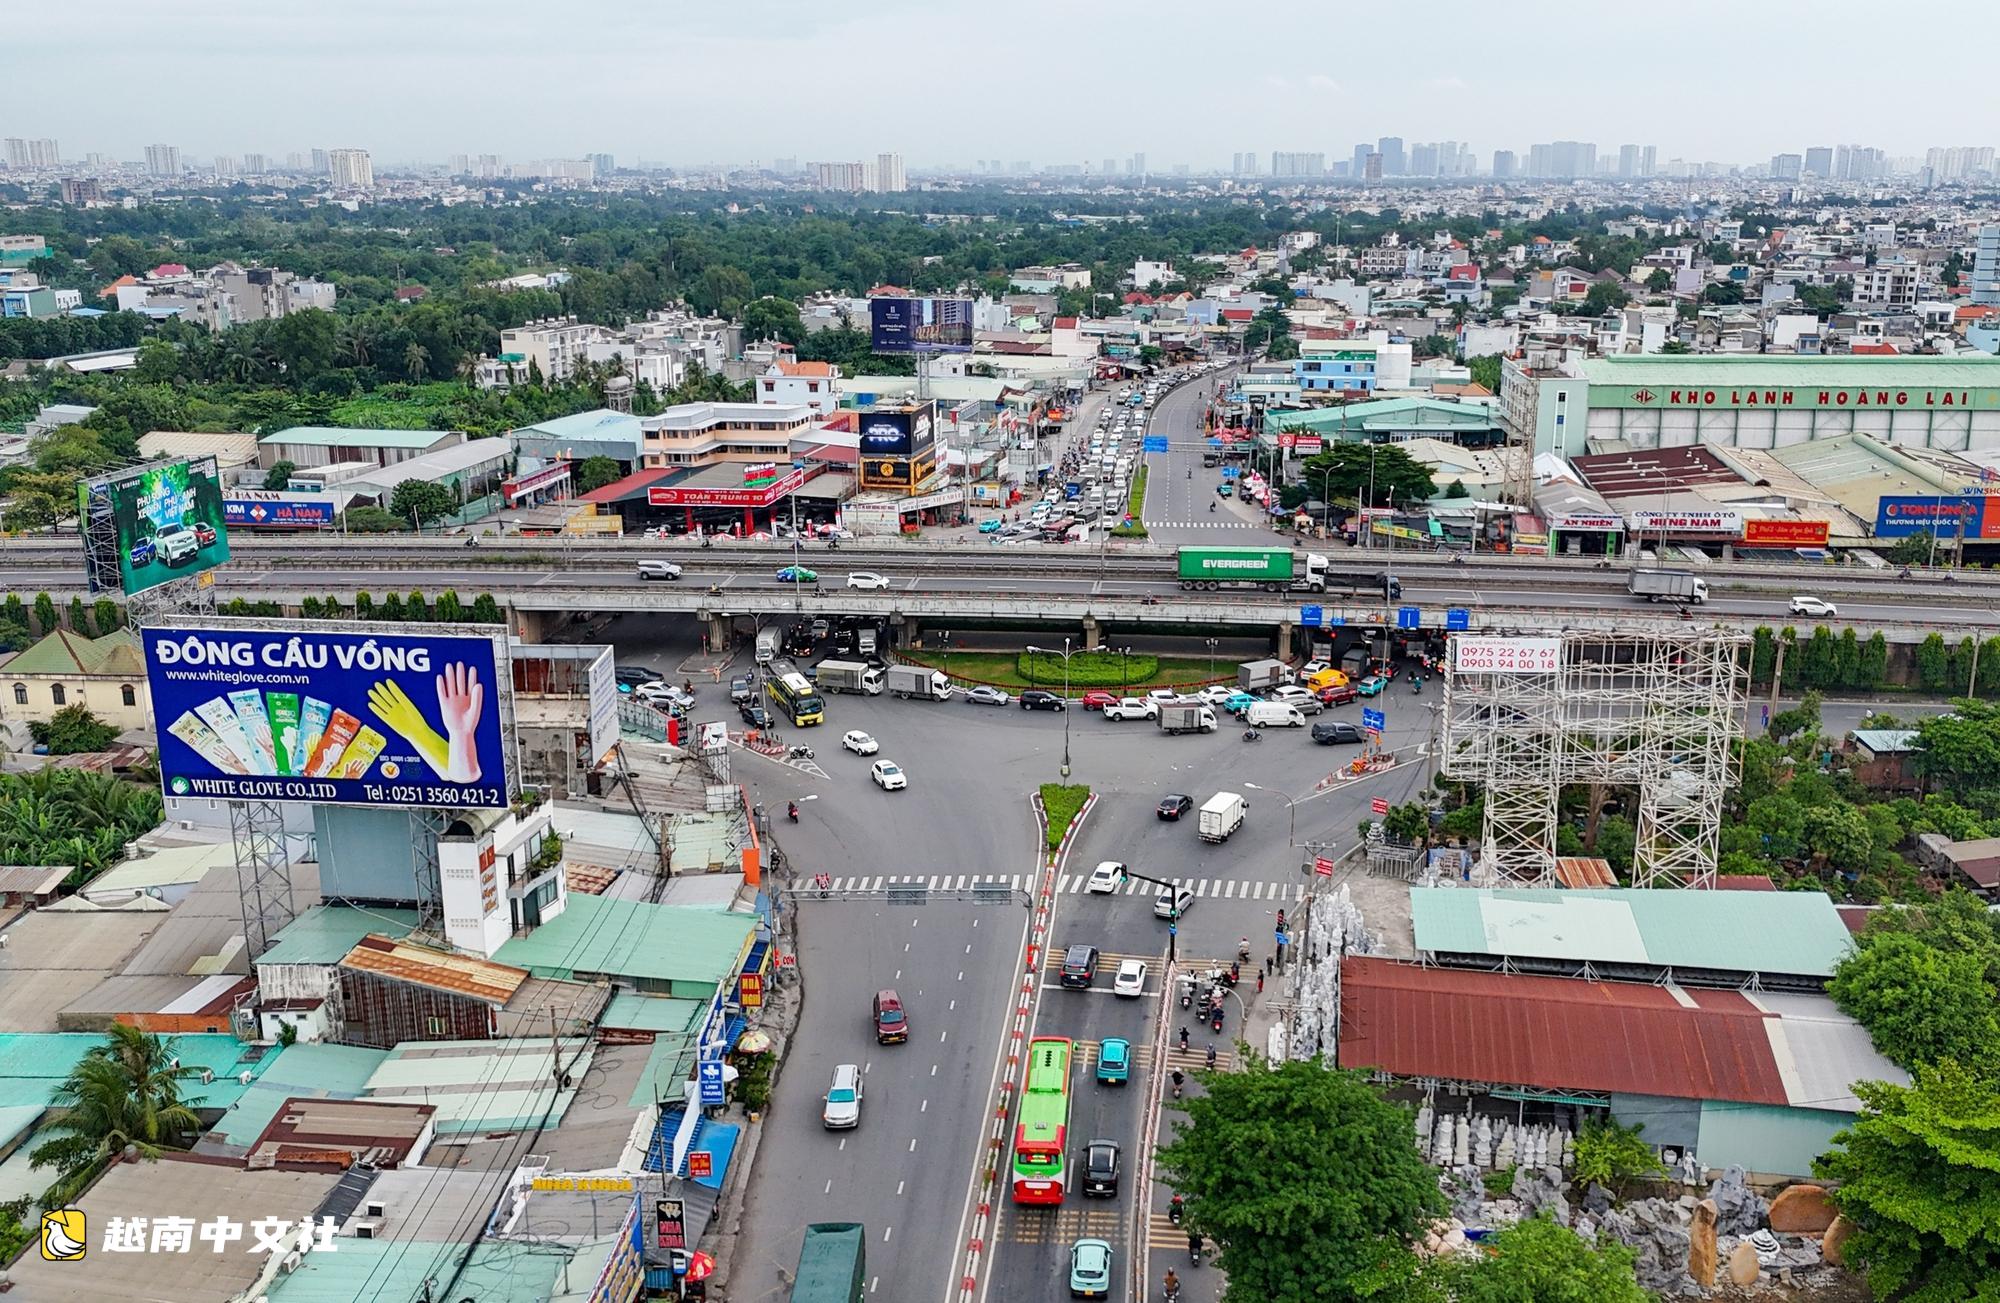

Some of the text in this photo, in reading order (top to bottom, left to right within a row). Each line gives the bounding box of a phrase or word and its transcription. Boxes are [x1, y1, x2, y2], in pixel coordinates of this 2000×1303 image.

[1671, 389, 1968, 407] KHO LẠNH HOÀNG LAI
[227, 504, 245, 514] KIM
[295, 509, 323, 518] NAM
[1581, 518, 1613, 527] NHIÊN
[1689, 518, 1721, 527] NAM
[1202, 559, 1268, 569] EVERGREEN
[155, 635, 431, 673] ĐÔNG CẦU VỒNG
[1461, 647, 1556, 658] 0975 22 67 67
[1461, 658, 1555, 669] 0903 94 00 18
[166, 669, 310, 685] www.whiteglove.com.vn
[190, 779, 337, 799] WHITE GLOVE CO.,LTD
[391, 786, 423, 802] 0251
[426, 787, 459, 803] 3560
[461, 788, 499, 804] 421-2
